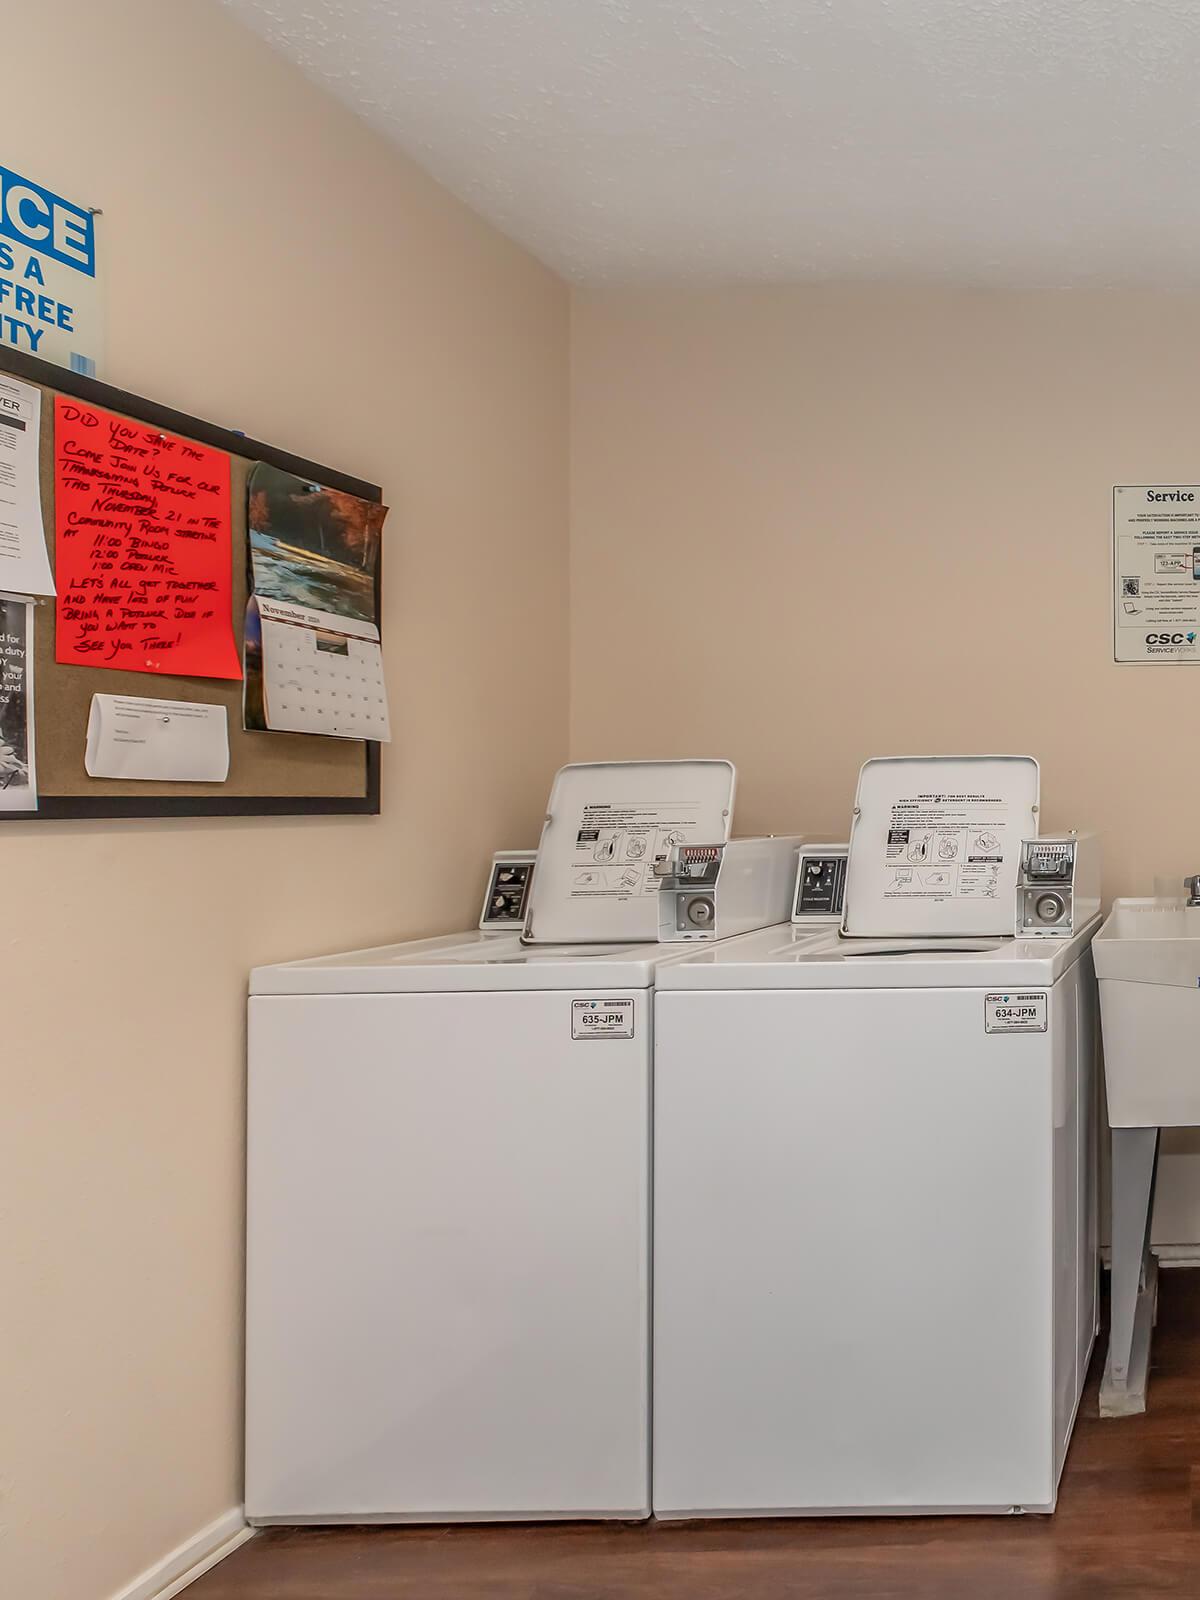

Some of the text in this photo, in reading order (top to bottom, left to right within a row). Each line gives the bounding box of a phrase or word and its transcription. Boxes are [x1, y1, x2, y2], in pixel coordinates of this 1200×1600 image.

[0, 175, 89, 265] CE
[24, 256, 45, 286] A
[61, 406, 205, 461] DID YOU SAVE THE
[63, 441, 103, 464] COME
[167, 473, 193, 486] FOR
[197, 482, 221, 496] OUR
[1147, 490, 1195, 502] Service
[91, 497, 160, 521] NOVEMBER
[165, 510, 182, 522] 21
[202, 517, 222, 529] THE
[64, 530, 79, 538] AT
[93, 534, 170, 550] 11:00 BINGO
[90, 549, 119, 559] 12:00
[92, 562, 114, 570] 1:00
[120, 562, 148, 572] OPEN
[110, 578, 132, 589] ALL
[166, 581, 220, 592] TOGETHER
[64, 594, 86, 605] AND
[93, 594, 122, 604] HAVE
[156, 595, 170, 604] OF
[175, 595, 199, 604] FUN
[62, 607, 100, 621] BRING
[106, 609, 113, 618] A
[262, 604, 306, 621] November
[7, 635, 20, 644] for
[1146, 633, 1184, 645] CSC
[74, 640, 105, 653] SEE
[3, 672, 22, 680] your
[5, 684, 21, 692] and
[583, 1015, 624, 1024] 635-JPM
[996, 1009, 1037, 1018] 634-JPM
